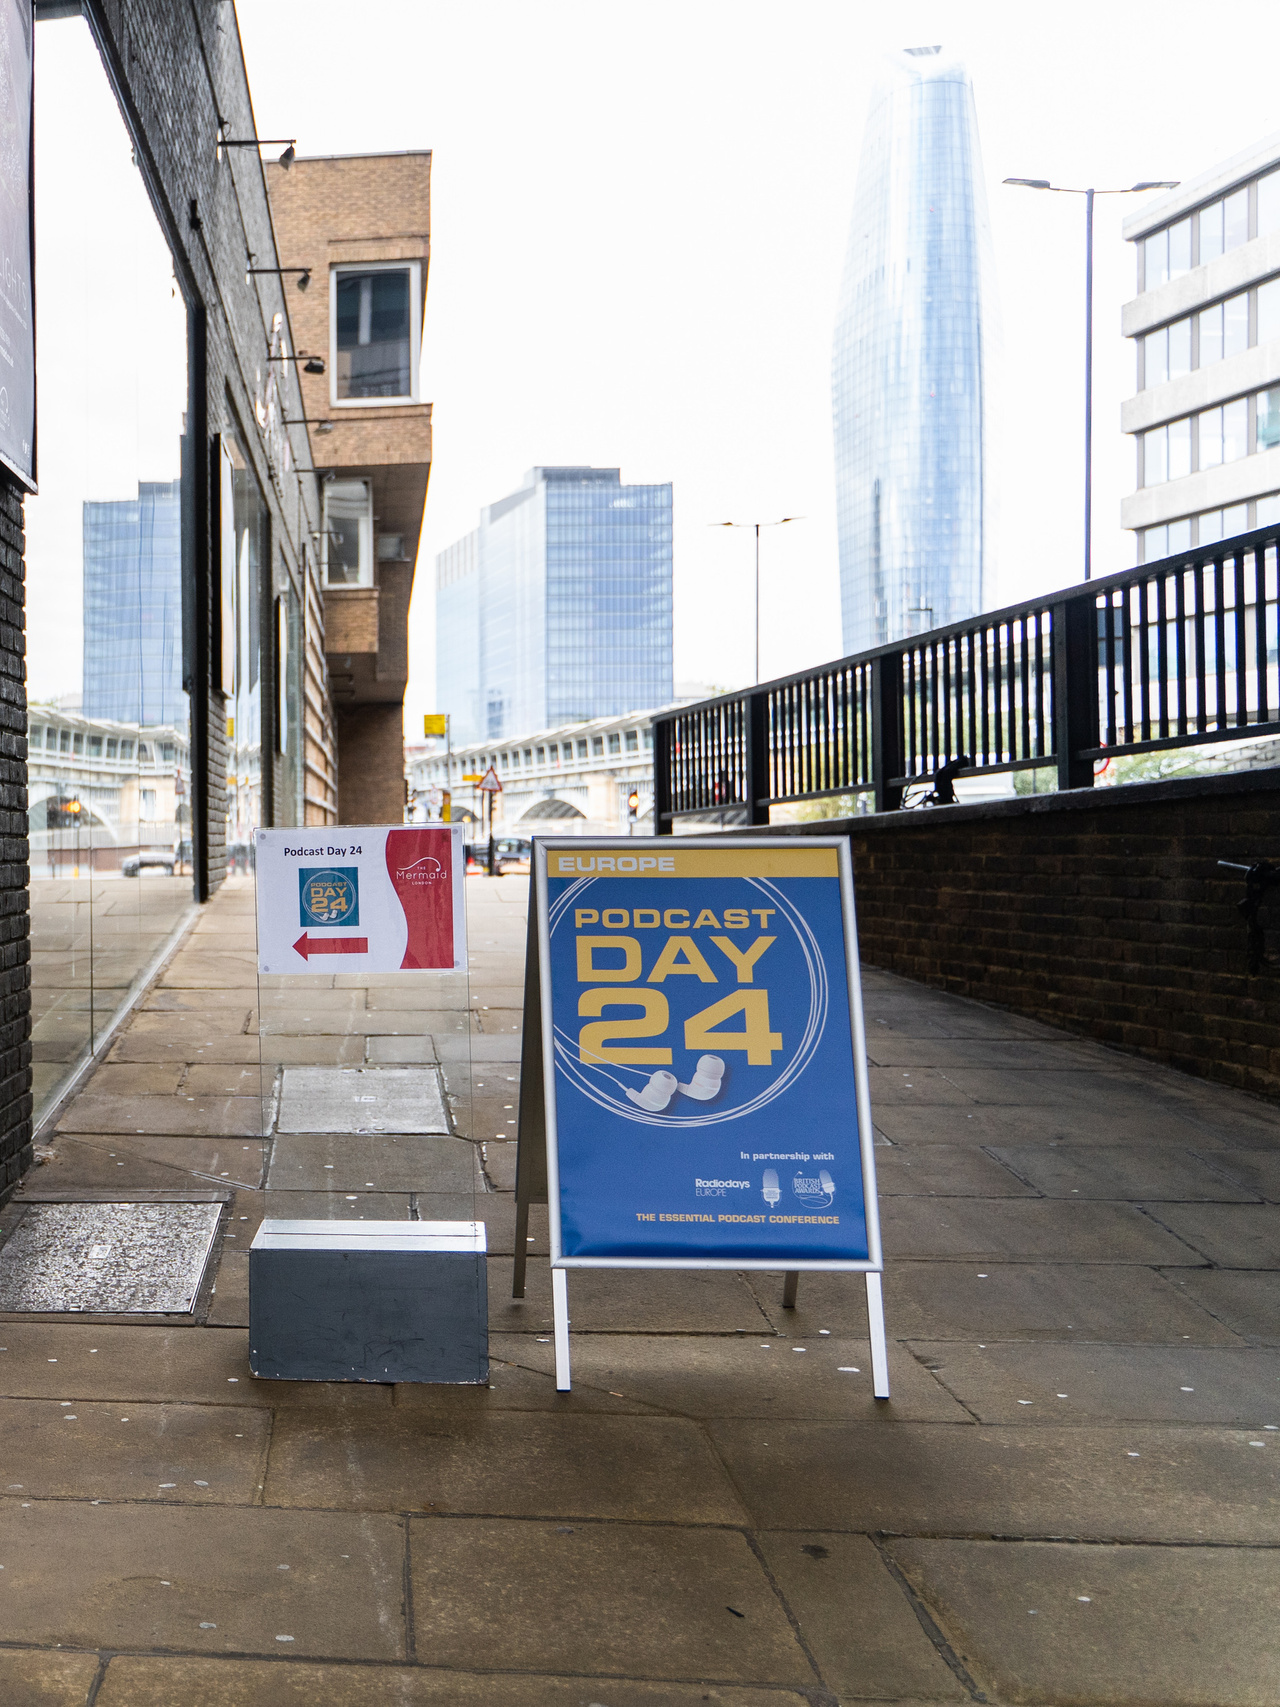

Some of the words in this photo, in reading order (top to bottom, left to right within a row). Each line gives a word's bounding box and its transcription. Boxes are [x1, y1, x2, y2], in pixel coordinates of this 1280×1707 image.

[284, 847, 324, 857] Podcast
[327, 846, 347, 857] Day
[349, 846, 363, 855] 24
[558, 857, 675, 872] EUROPE
[396, 870, 447, 880] Mermaid
[311, 887, 347, 897] DAY
[311, 897, 348, 912] 24
[574, 908, 776, 929] PODCAST
[575, 935, 778, 983] DAY
[577, 987, 783, 1065] 24
[740, 1151, 750, 1160] In
[752, 1151, 810, 1162] partnership
[813, 1152, 835, 1161] with
[695, 1178, 751, 1189] Radiodays
[695, 1188, 727, 1197] EUROPE
[636, 1213, 656, 1222] THE
[659, 1213, 716, 1223] ESSENTIAL
[718, 1214, 766, 1224] PODCAST
[769, 1215, 840, 1225] CONFERENCE
